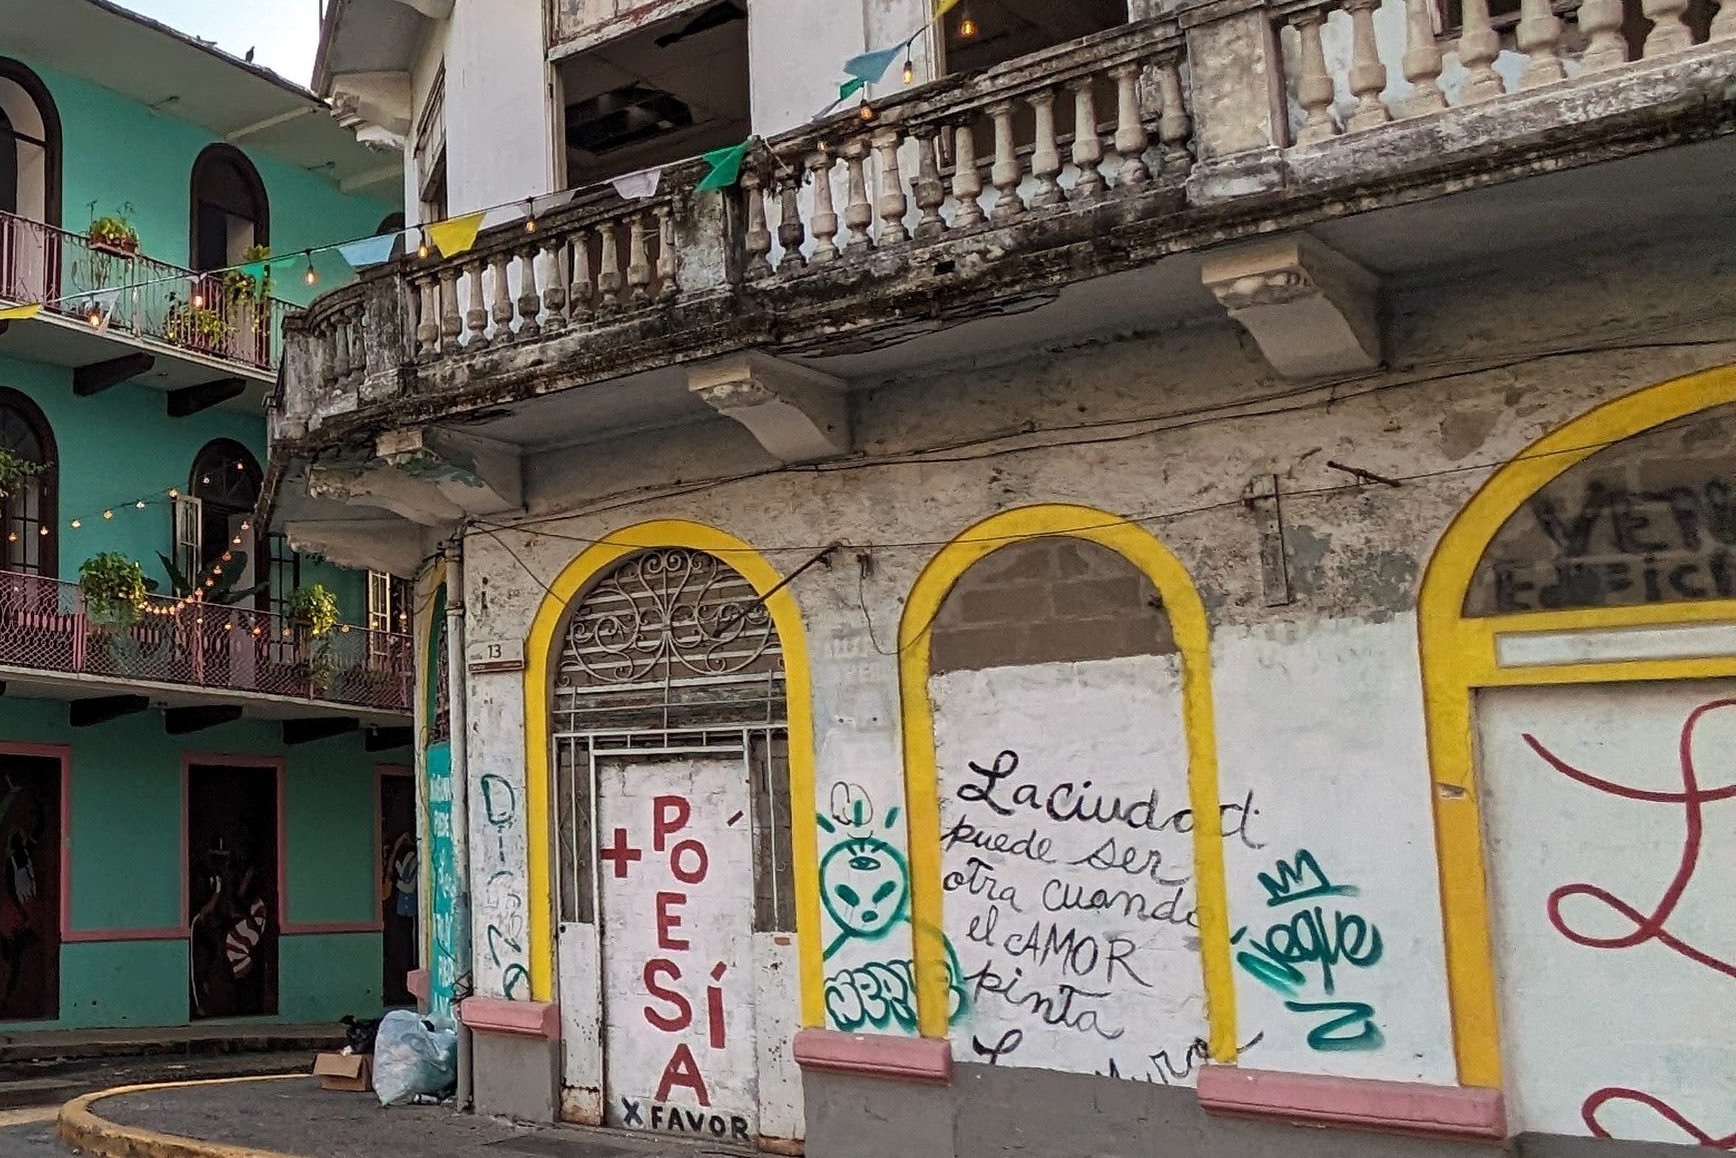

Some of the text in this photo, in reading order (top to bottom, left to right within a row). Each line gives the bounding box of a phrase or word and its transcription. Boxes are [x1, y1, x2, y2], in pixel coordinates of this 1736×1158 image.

[487, 643, 502, 659] 13
[957, 750, 1042, 816] La
[940, 814, 1192, 886] puede ser
[943, 857, 1023, 913] otra
[966, 904, 999, 947] el
[963, 959, 1125, 1040] pinta
[622, 1096, 751, 1142] X FAVOR
